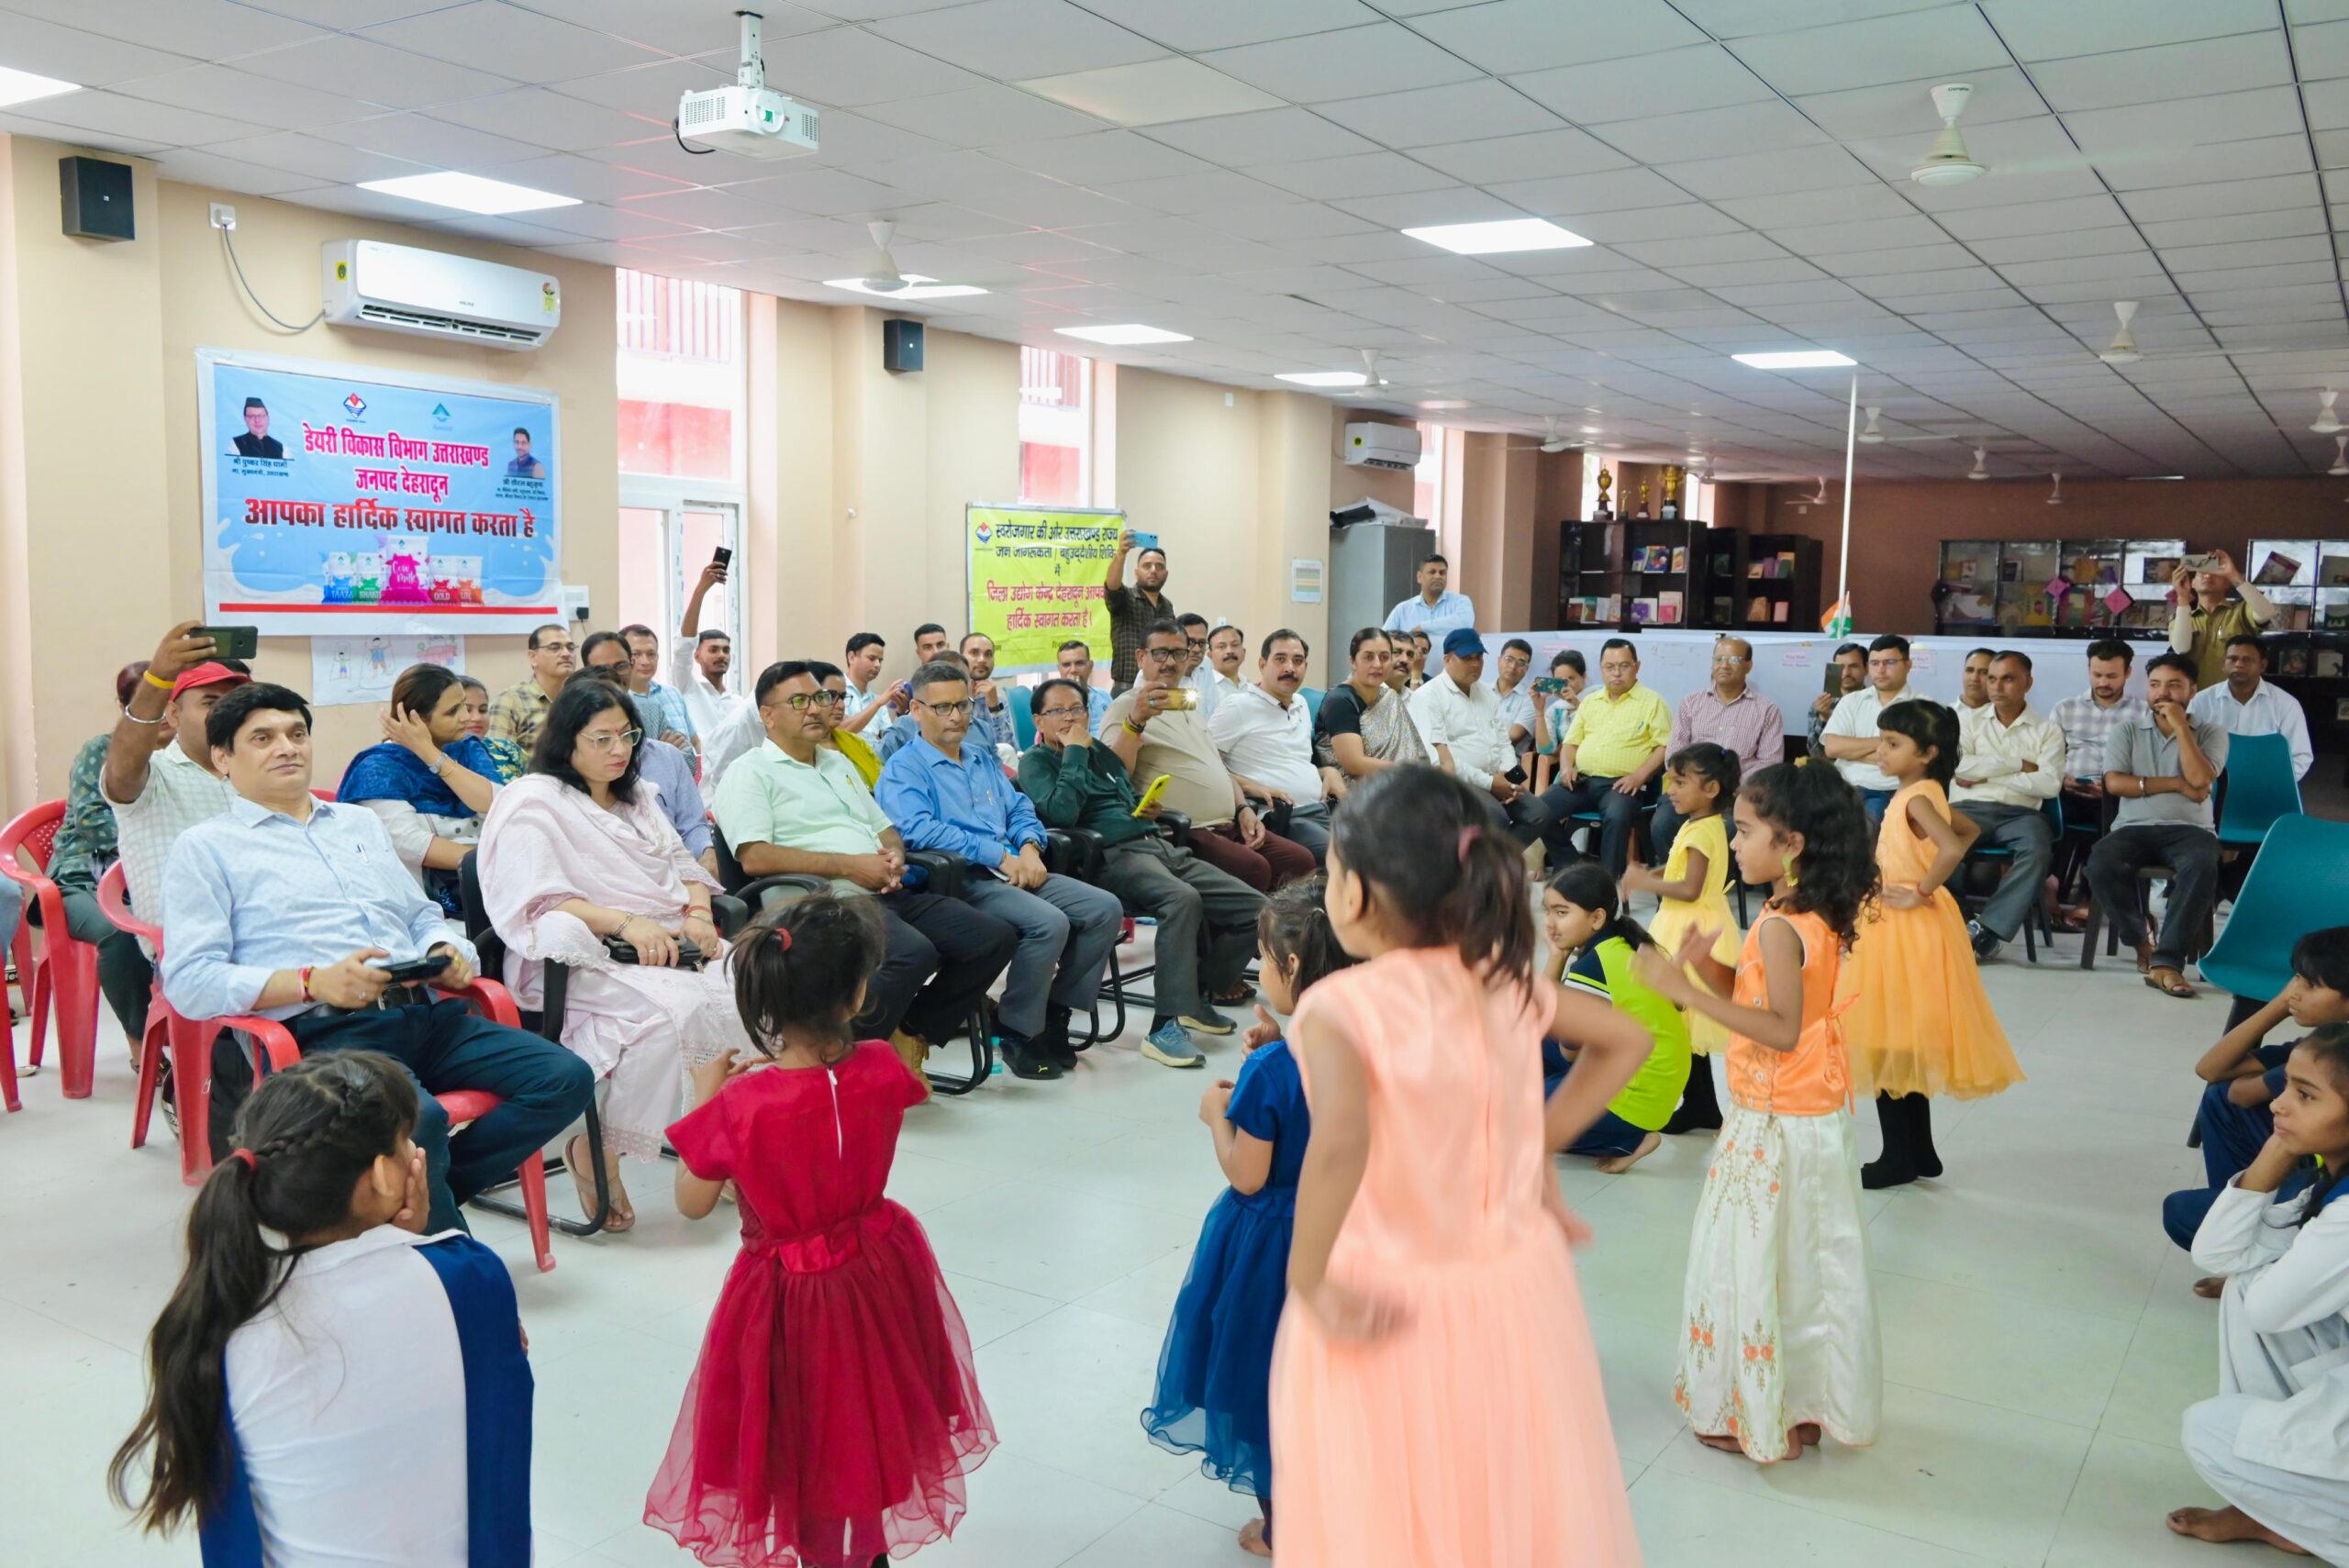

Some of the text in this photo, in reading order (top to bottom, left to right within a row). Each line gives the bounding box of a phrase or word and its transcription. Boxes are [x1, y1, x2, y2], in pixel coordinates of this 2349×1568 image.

[303, 423, 489, 467] डेयरी विकास विभाग उत्तराखण्ड
[355, 466, 449, 503] जनपद देहरादून
[245, 498, 535, 538] आपका हार्दिक स्वागत करता है
[996, 519, 1118, 541] स्वरोजगार की ओर उत्तराखण्ड राज्य
[996, 546, 1010, 558] जन
[987, 580, 1008, 602] जिला
[1055, 581, 1084, 607] देहरादून
[1007, 607, 1031, 630] हार्दिक
[1035, 612, 1059, 628] स्वागत
[1062, 612, 1081, 627] करता
